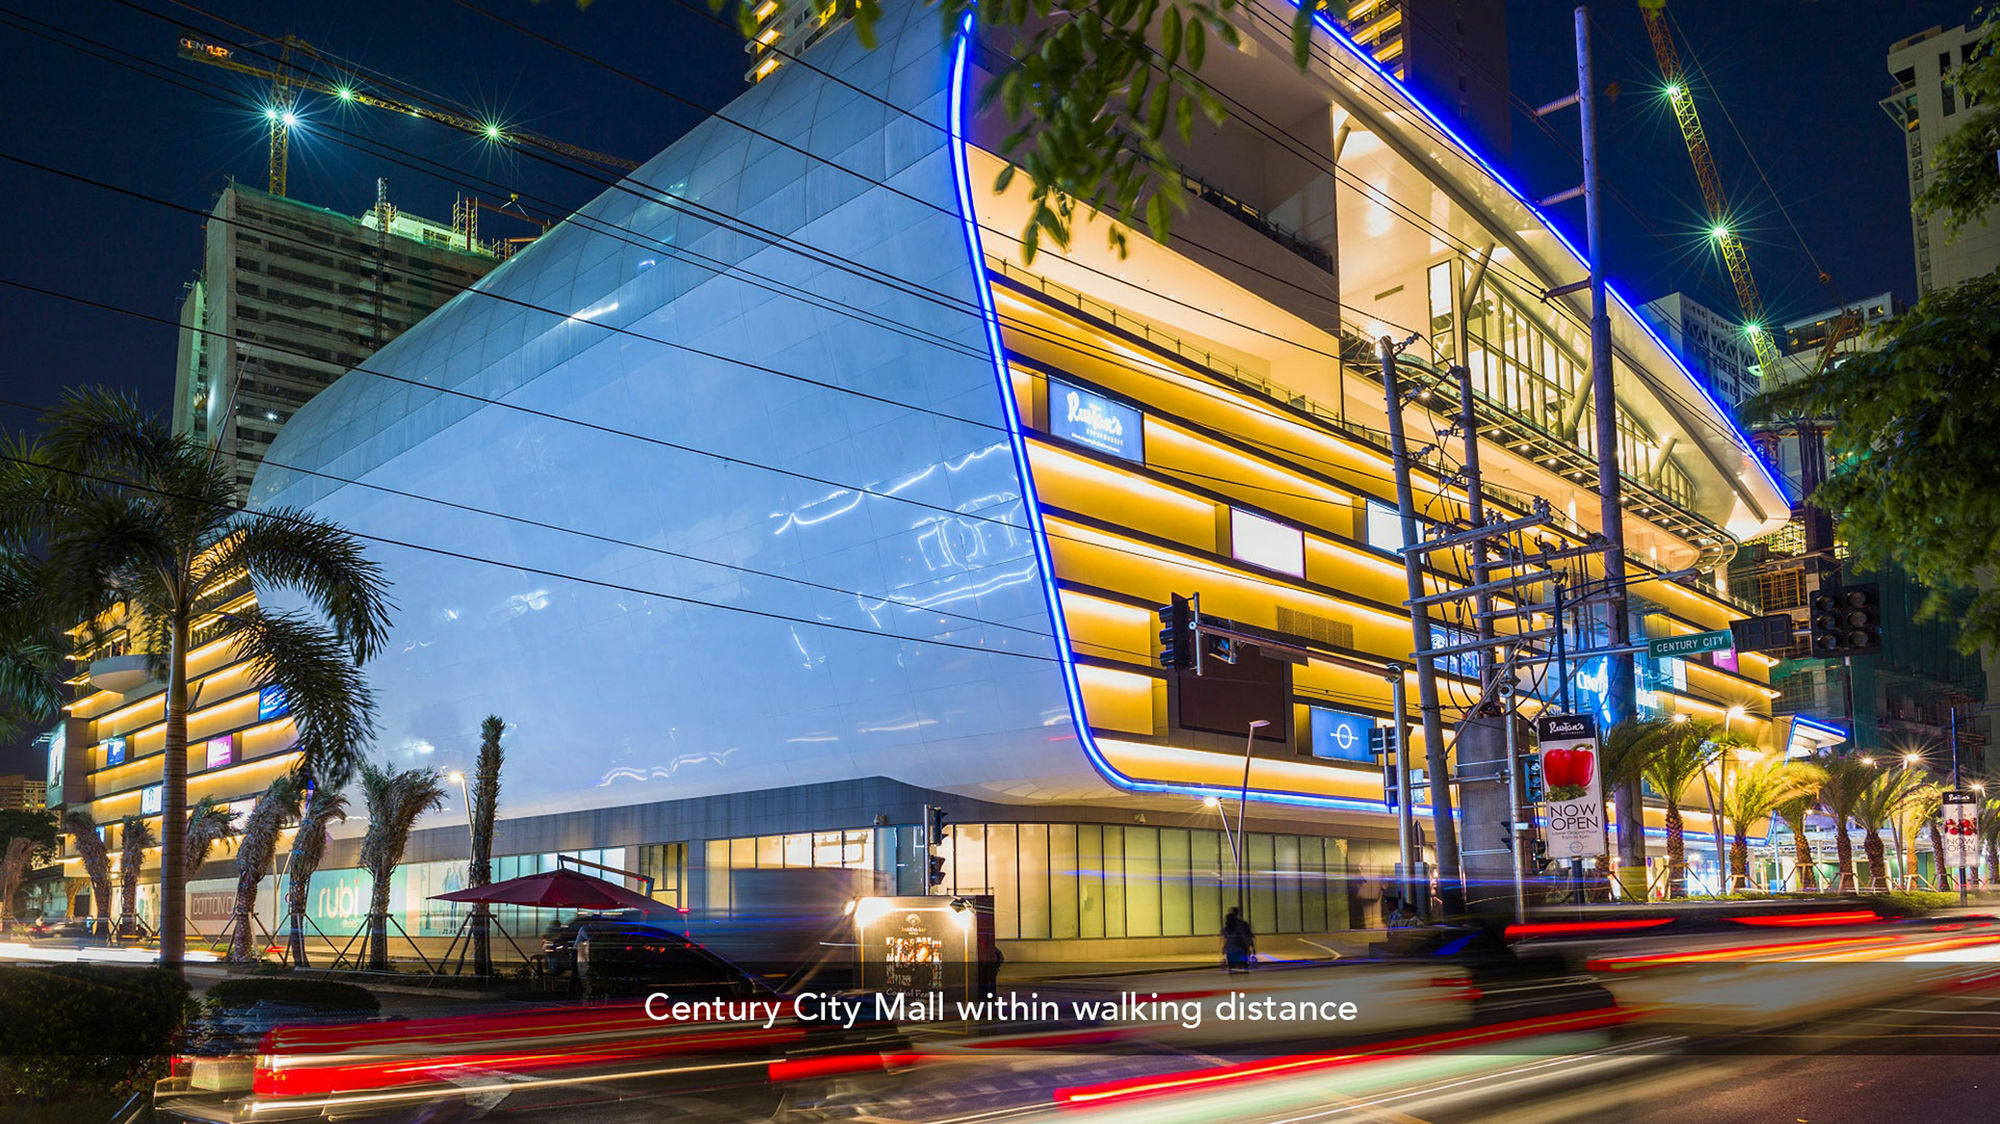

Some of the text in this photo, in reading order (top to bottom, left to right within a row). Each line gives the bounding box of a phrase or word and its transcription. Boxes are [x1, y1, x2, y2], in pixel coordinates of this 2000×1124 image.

[179, 37, 234, 59] CENTURY
[1656, 635, 1725, 653] CENTURY CITY
[1549, 721, 1585, 734] Rustan's
[1550, 803, 1597, 818] NOW
[1551, 816, 1599, 831] OPEN
[1946, 837, 1975, 845] NOW
[1947, 844, 1976, 852] OPEN
[193, 896, 225, 915] COTTON
[318, 878, 360, 919] rubi
